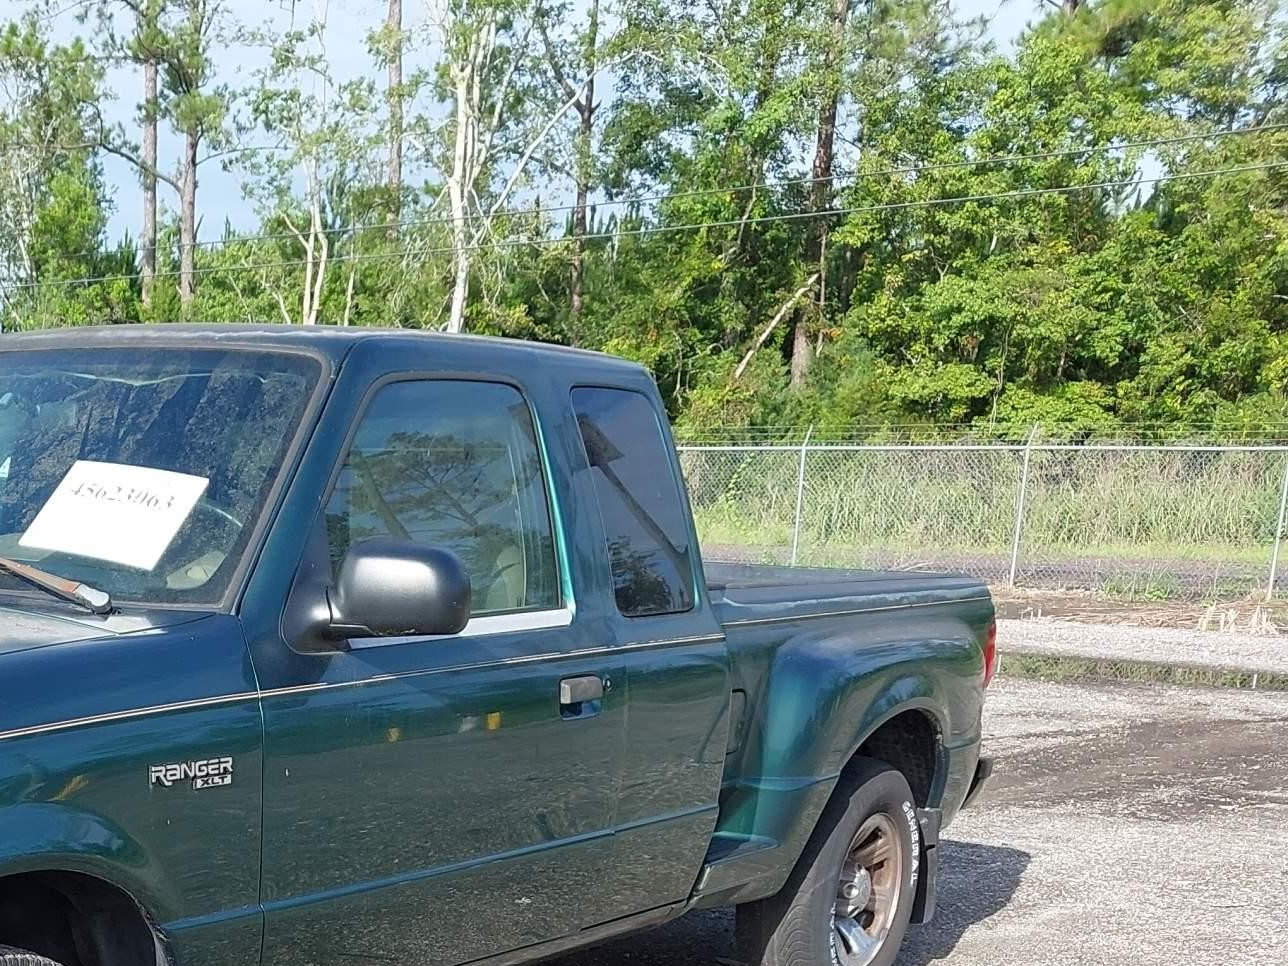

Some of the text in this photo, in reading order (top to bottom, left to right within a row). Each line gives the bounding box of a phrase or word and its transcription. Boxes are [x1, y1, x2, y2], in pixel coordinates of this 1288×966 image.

[149, 757, 233, 786] RANGER
[200, 775, 228, 787] XLT
[902, 801, 920, 886] GENERAL
